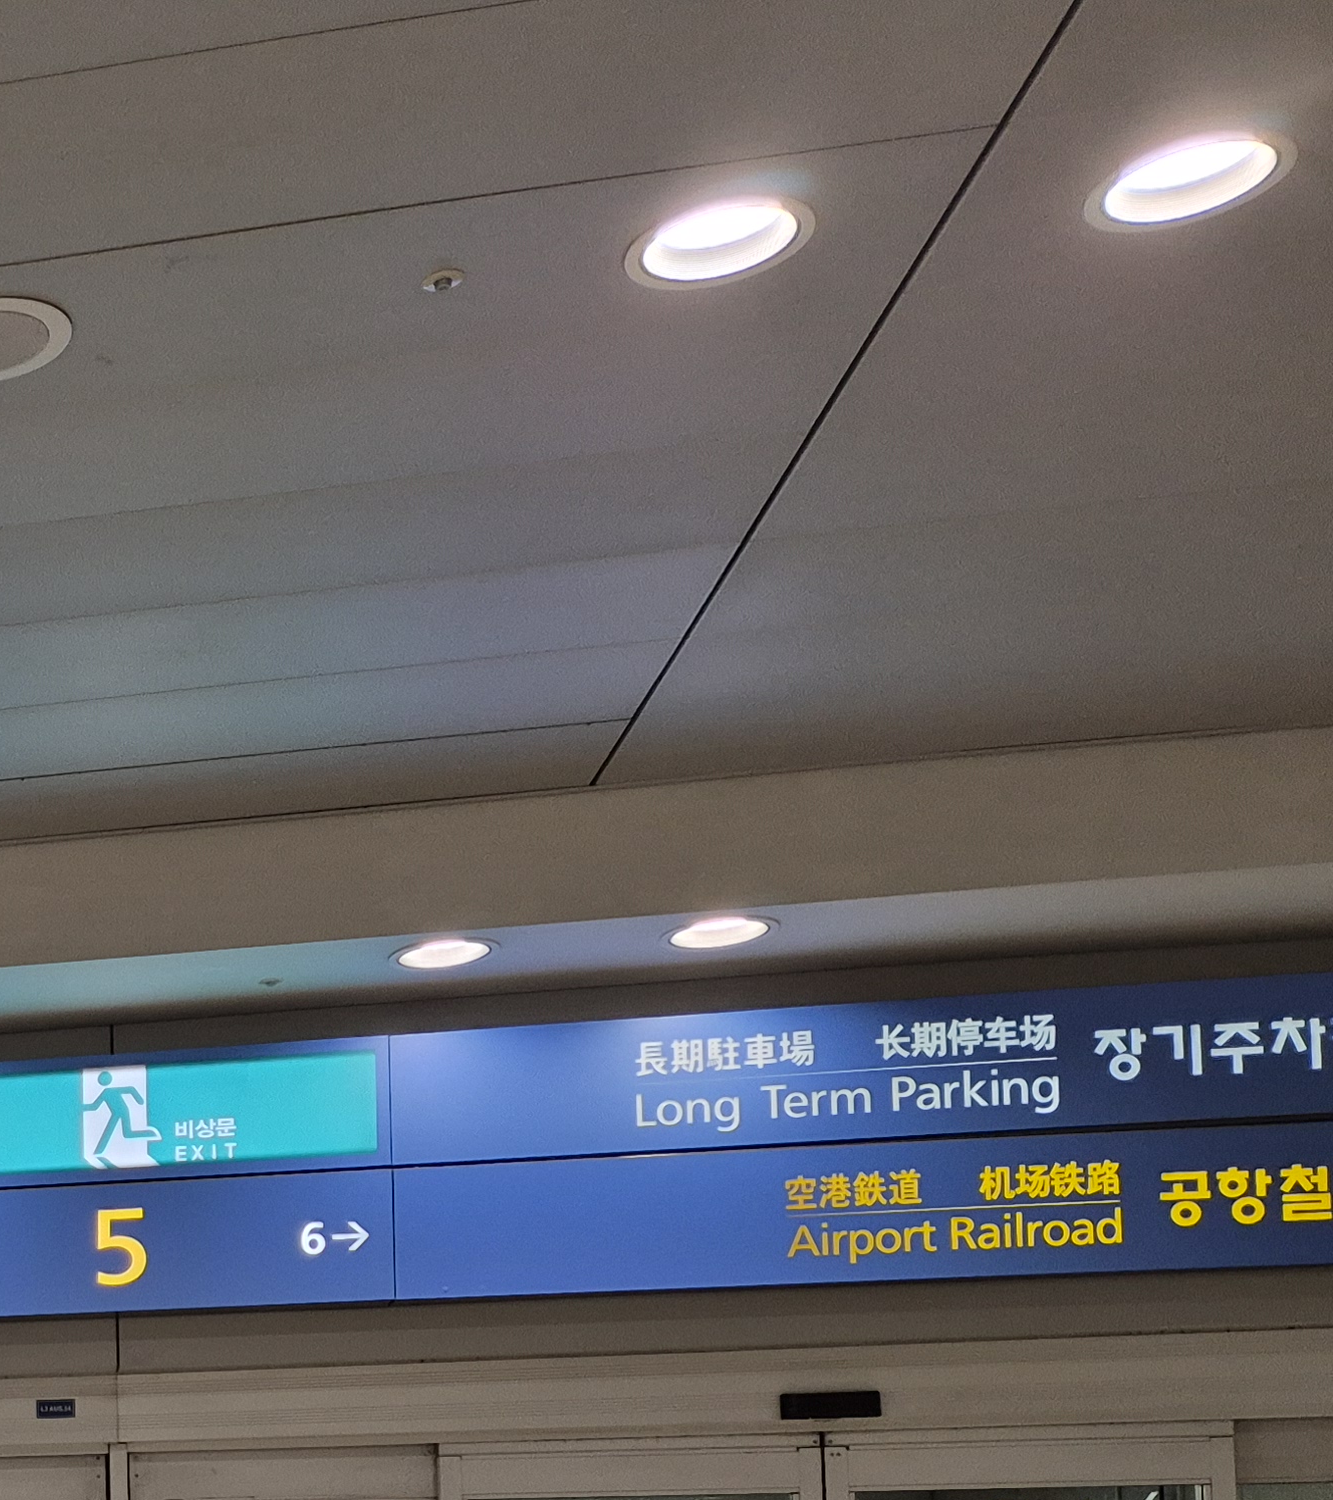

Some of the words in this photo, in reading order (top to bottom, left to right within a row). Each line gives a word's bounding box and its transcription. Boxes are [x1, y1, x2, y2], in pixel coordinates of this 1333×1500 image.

[635, 1031, 814, 1076] 長期駐車場
[875, 1014, 1057, 1060] 长期停车场
[1093, 1016, 1333, 1082] 장기주차
[175, 1118, 237, 1138] 비상문
[636, 1094, 739, 1131] Long
[760, 1085, 871, 1118] Term
[892, 1069, 1059, 1113] Parking
[175, 1142, 237, 1162] EXIT
[785, 1169, 922, 1210] 空港鉄道
[980, 1160, 1121, 1200] 机场铁路
[97, 1208, 146, 1286] 5
[301, 1222, 325, 1254] 6
[788, 1221, 937, 1264] Airport
[950, 1207, 1122, 1250] Railroad
